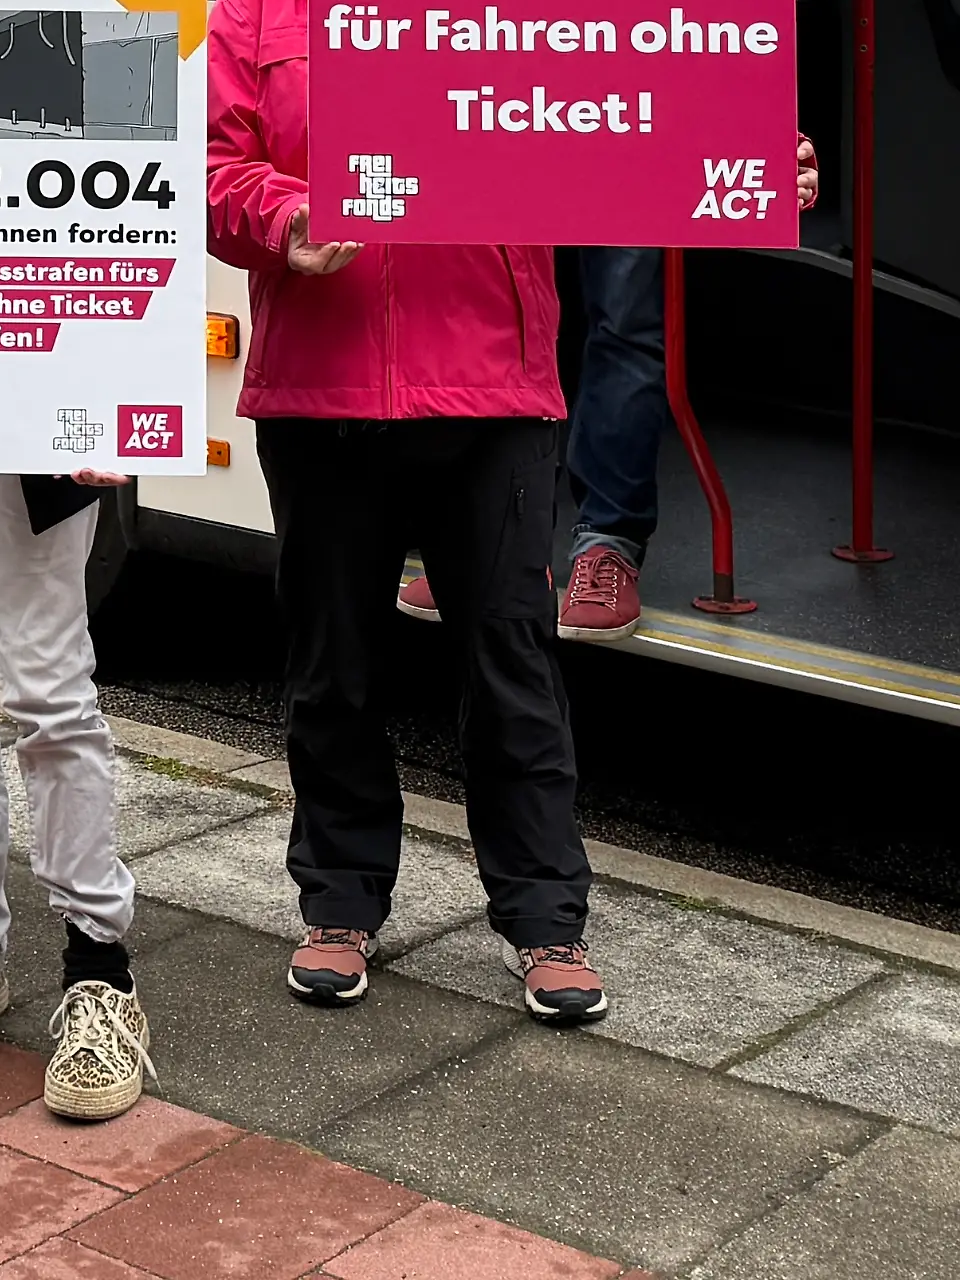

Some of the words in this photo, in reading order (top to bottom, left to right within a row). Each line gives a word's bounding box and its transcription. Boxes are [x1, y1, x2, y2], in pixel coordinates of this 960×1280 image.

[323, 4, 412, 51] für
[425, 6, 617, 53] Fahren
[630, 7, 779, 55] ohne
[447, 85, 652, 134] Ticket!
[703, 158, 766, 188] WE
[67, 222, 177, 244] fordern:
[108, 261, 159, 283] fürs
[49, 293, 134, 316] Ticket
[131, 412, 169, 431] WE
